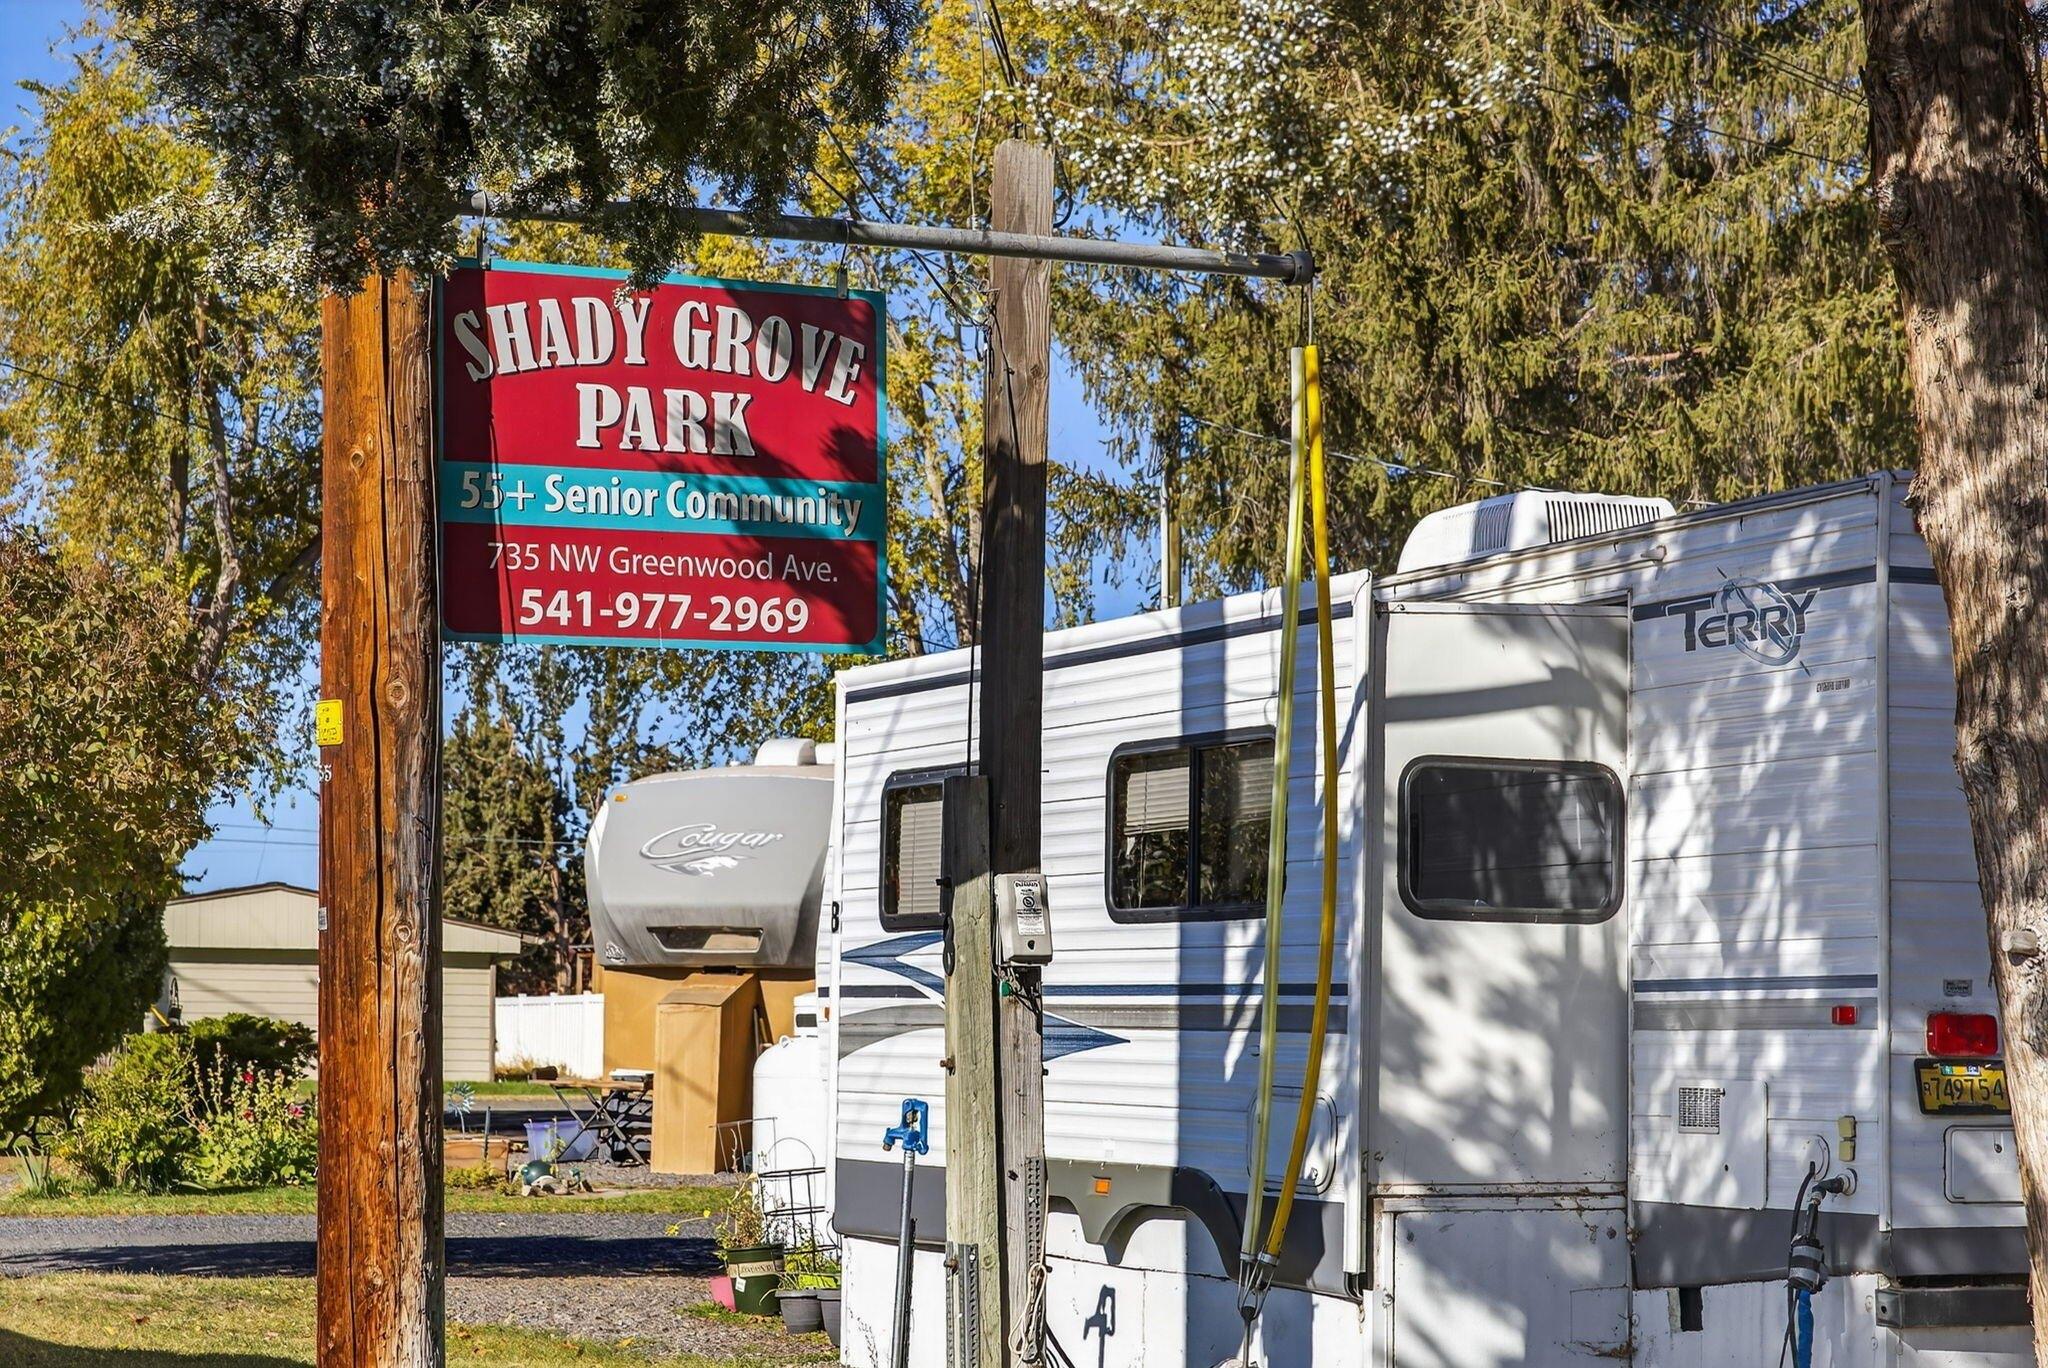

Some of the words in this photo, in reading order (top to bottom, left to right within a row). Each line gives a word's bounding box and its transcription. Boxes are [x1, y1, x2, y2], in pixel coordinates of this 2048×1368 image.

[454, 296, 651, 383] SHADY
[673, 300, 867, 406] GROVE
[575, 382, 756, 458] PARK
[459, 470, 536, 511] 55+
[544, 474, 660, 519] Senior
[667, 480, 862, 537] Community
[487, 542, 540, 572] 735
[550, 544, 602, 574] NW
[608, 546, 773, 581] Greenwood
[781, 553, 838, 583] Ave.
[519, 589, 809, 634] 541-977-2969
[1666, 587, 1821, 653] TERRY
[639, 822, 784, 860] Cougar
